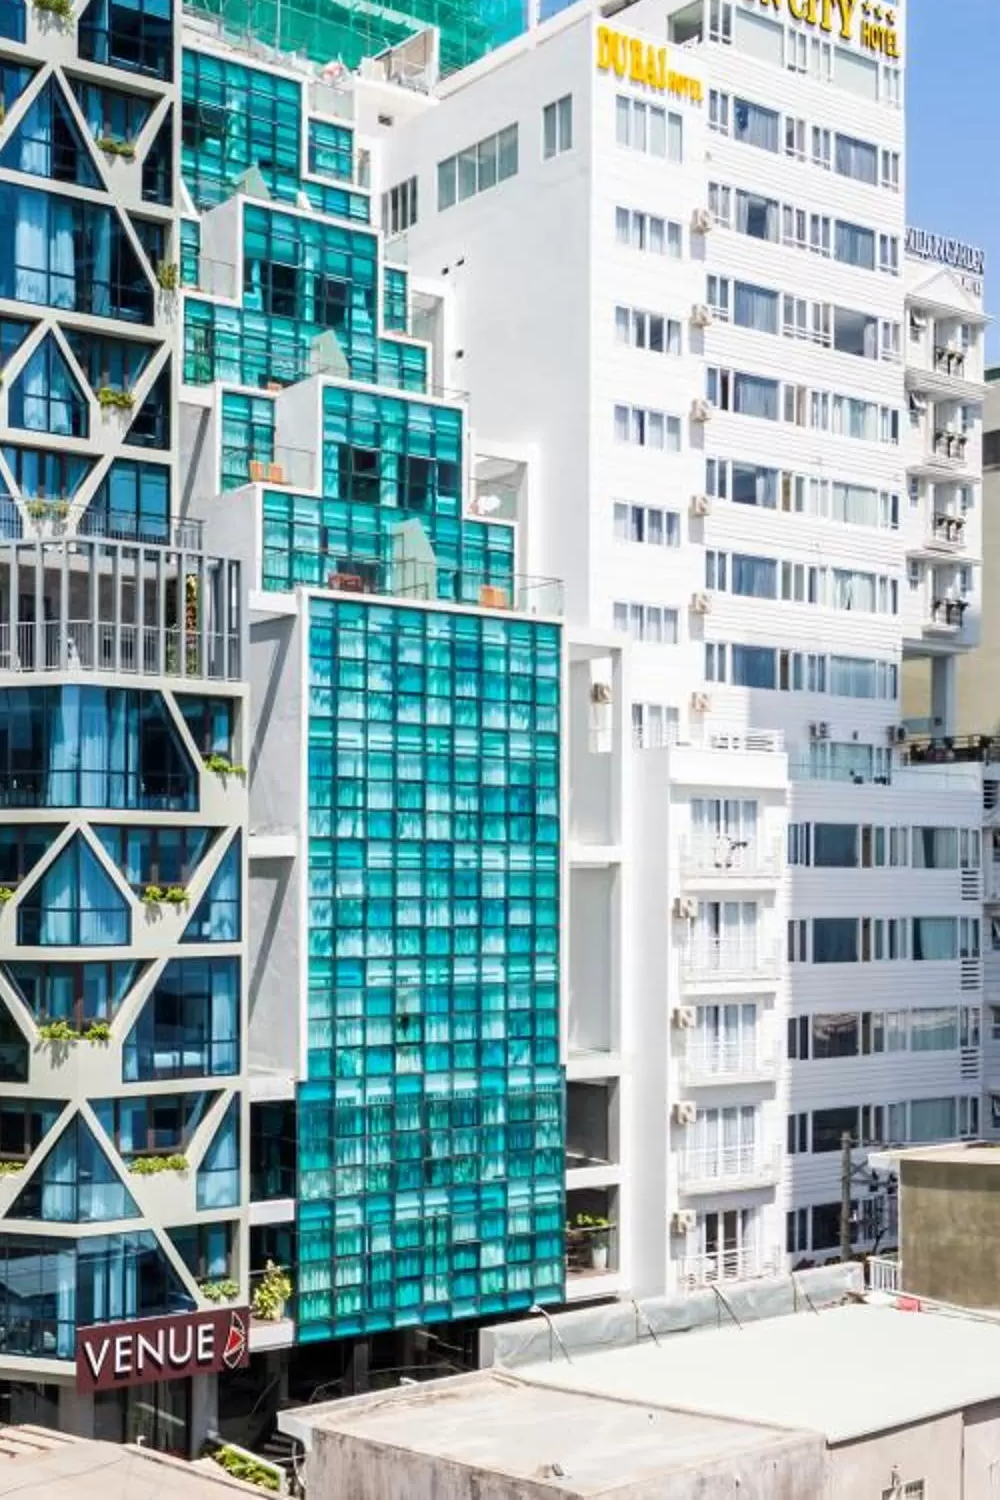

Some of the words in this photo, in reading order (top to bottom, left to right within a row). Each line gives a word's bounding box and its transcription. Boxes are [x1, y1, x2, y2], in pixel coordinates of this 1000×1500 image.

[597, 25, 666, 90] DUBAI
[859, 19, 900, 58] HOTEL
[84, 1323, 215, 1378] VENUE
